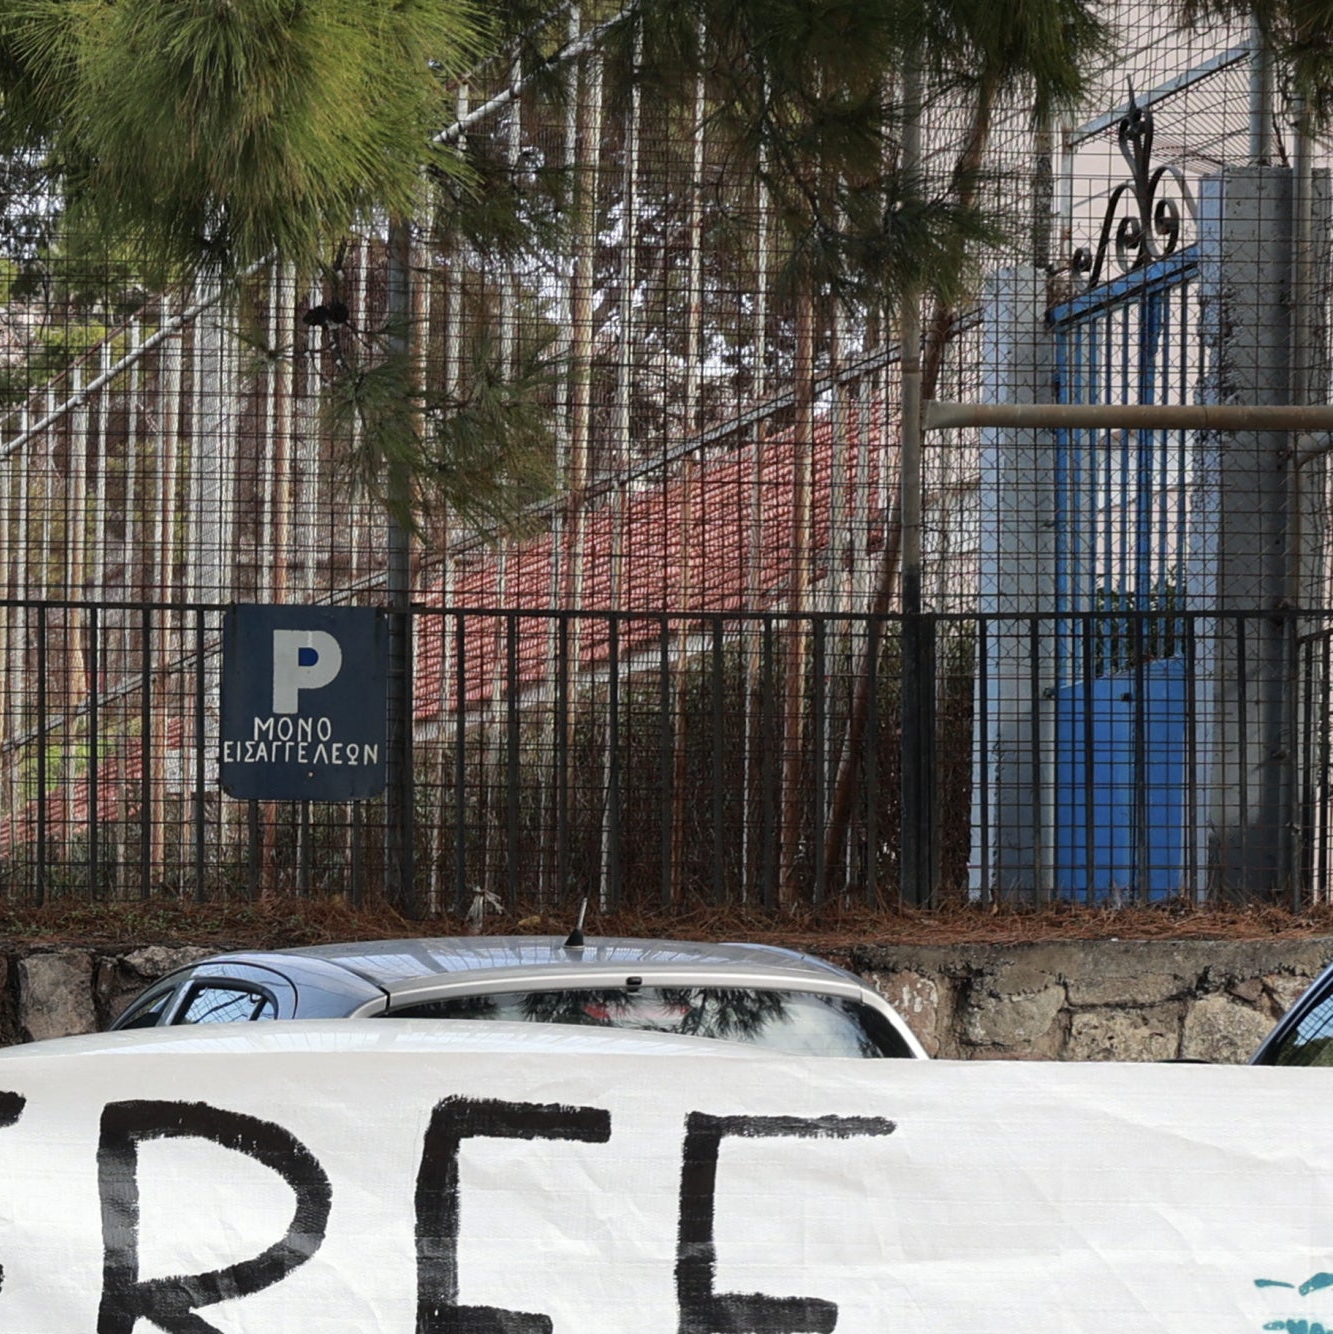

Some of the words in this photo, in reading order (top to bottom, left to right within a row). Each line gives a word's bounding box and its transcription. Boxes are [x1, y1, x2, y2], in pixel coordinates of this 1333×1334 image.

[272, 629, 343, 715] P
[253, 716, 332, 742] ΜΟΝΟ
[223, 741, 379, 765] ΕΙΣΑΓΓΕΛΕΩΝ
